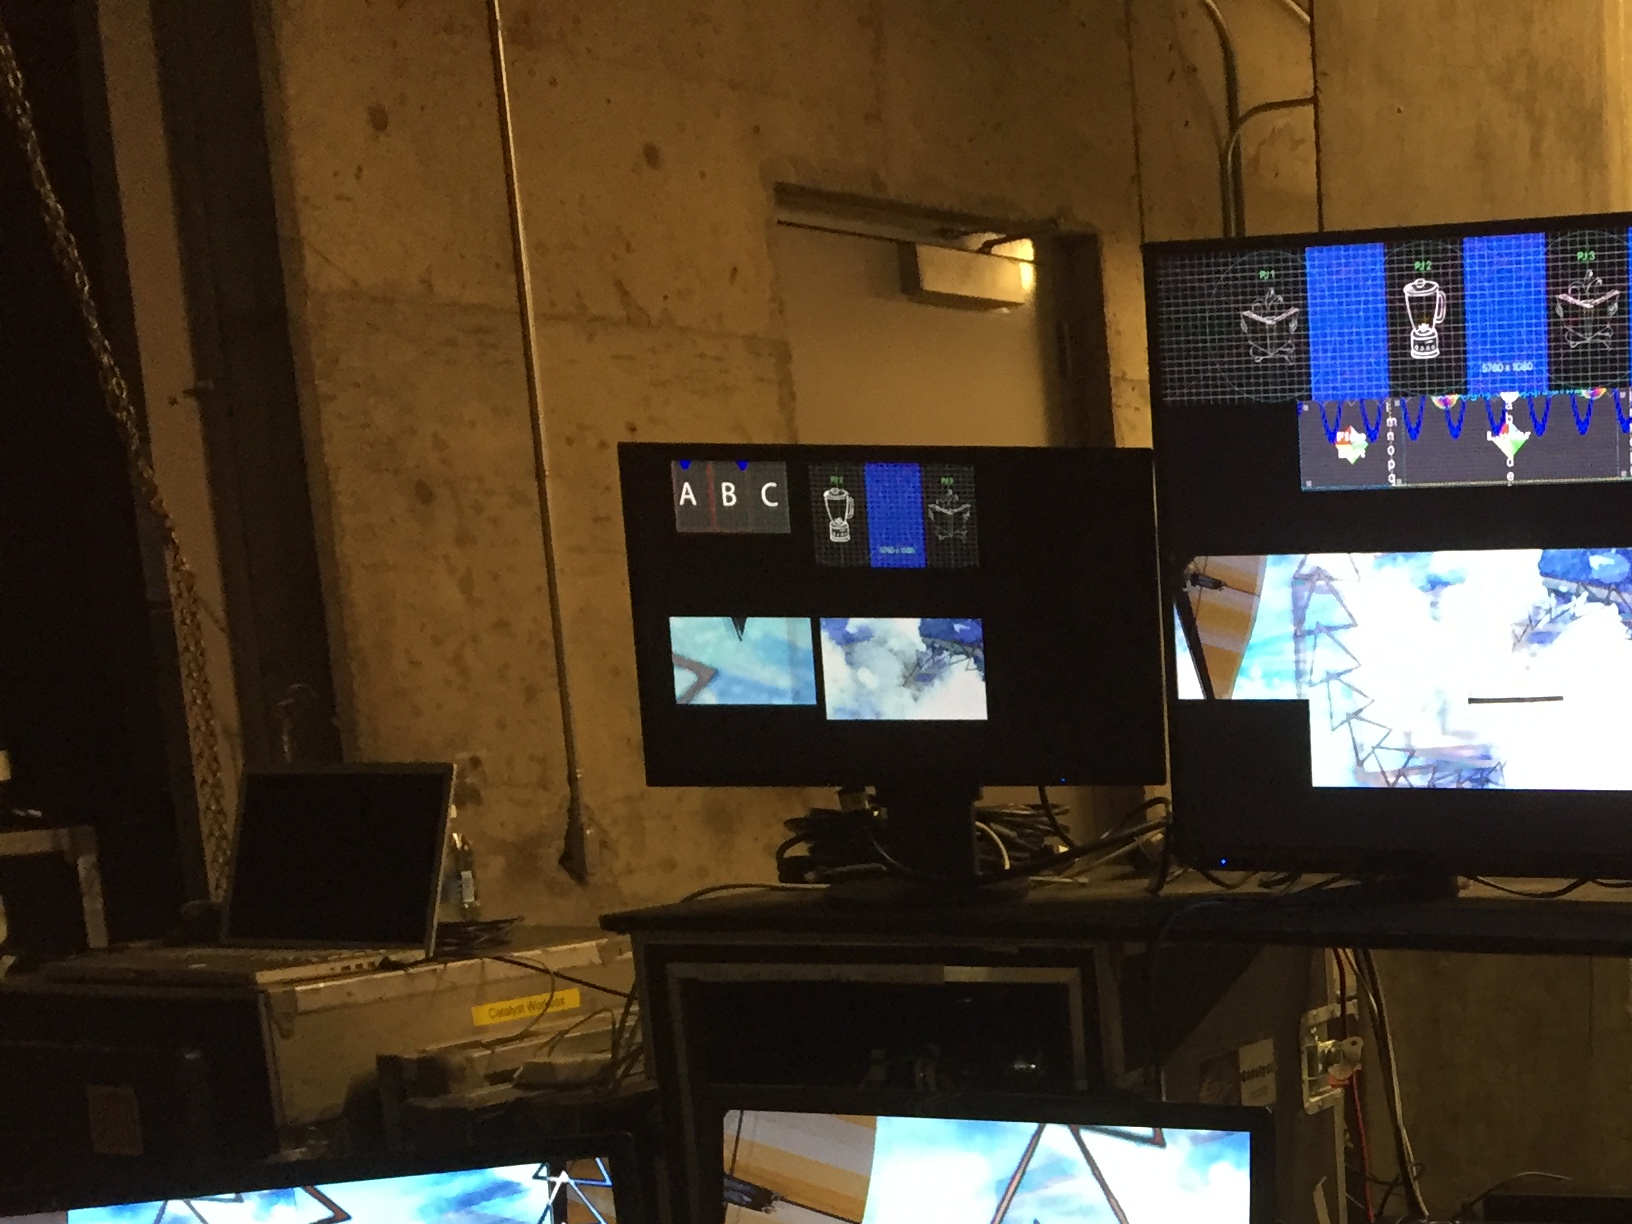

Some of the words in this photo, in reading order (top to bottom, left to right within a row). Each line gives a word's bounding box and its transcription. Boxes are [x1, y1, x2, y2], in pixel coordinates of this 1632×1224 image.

[679, 481, 698, 506] A
[721, 481, 738, 507] B
[760, 481, 779, 507] C
